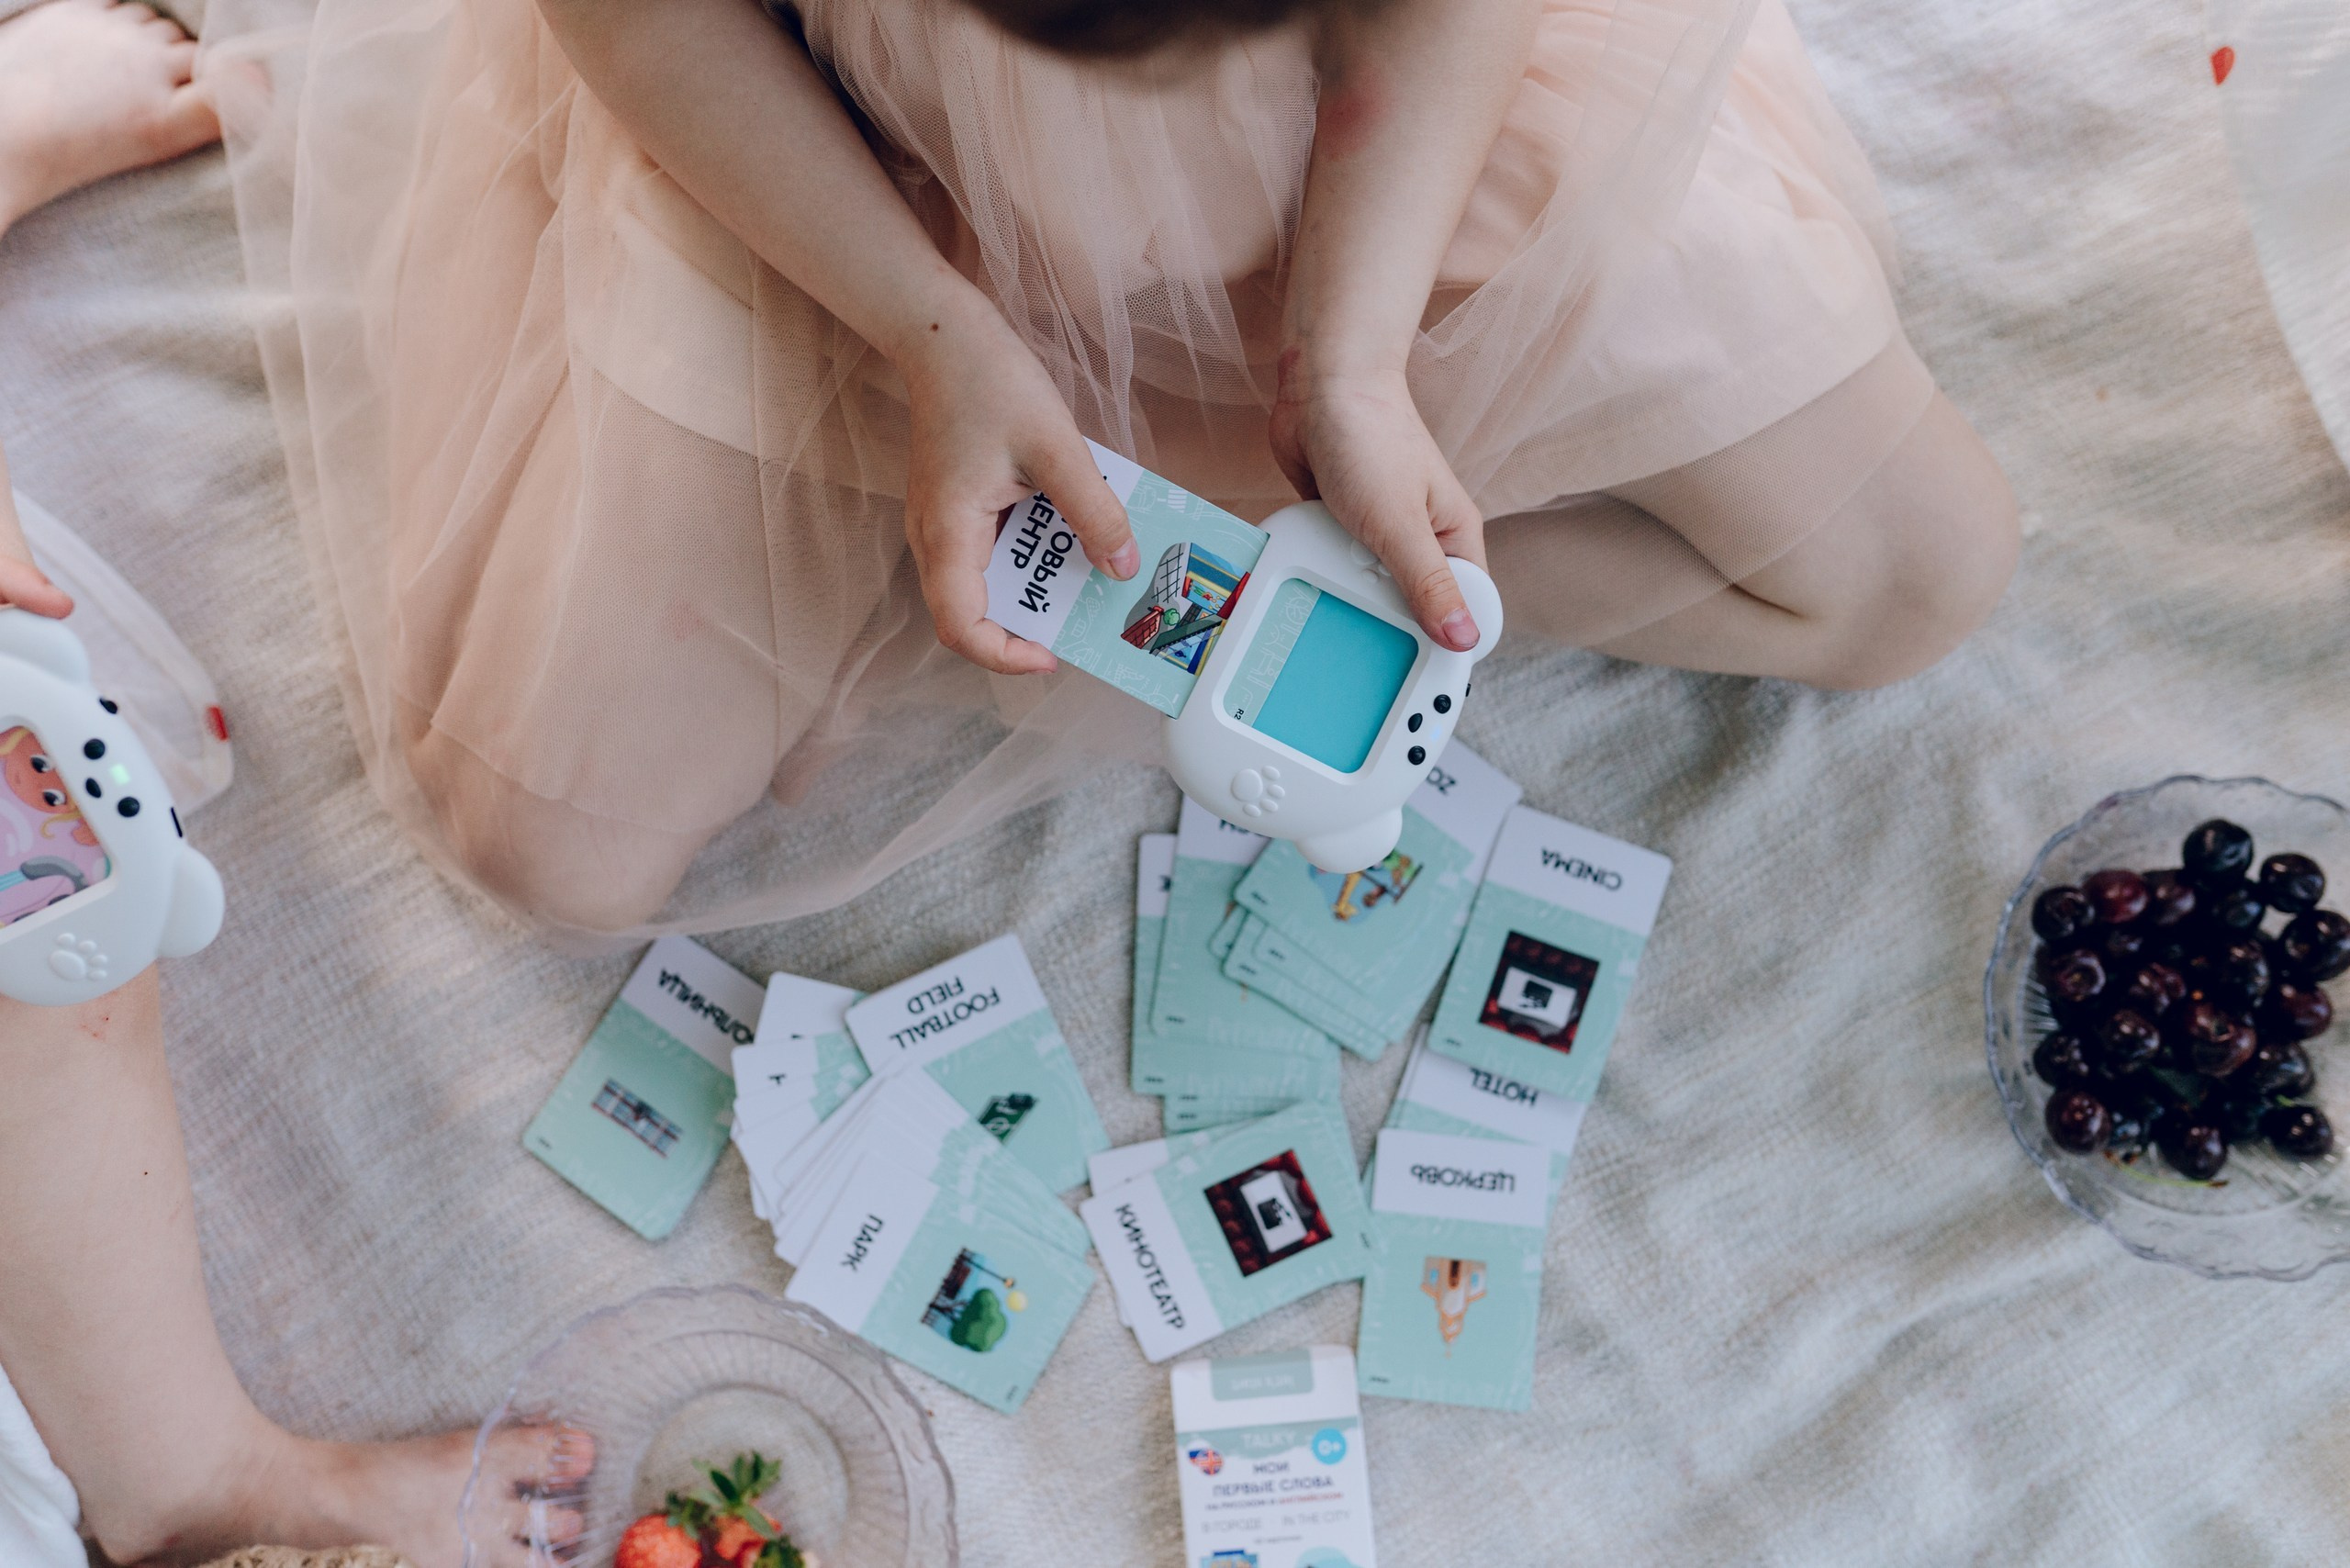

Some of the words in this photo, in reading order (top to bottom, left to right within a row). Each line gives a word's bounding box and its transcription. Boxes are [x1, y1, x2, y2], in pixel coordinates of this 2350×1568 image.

[1426, 766, 1457, 796] ZO
[1540, 846, 1622, 890] CINEMA
[907, 976, 965, 1014] FIELD
[889, 987, 1002, 1049] FOOTBALL
[1470, 1067, 1539, 1107] HOTEL
[1410, 1164, 1515, 1193] ЦЕРКОВЬ
[841, 1214, 885, 1271] ПАРК
[1114, 1203, 1186, 1330] КИНОТЕАТР
[1212, 1479, 1274, 1497] ПЕРВЫЕ
[1279, 1476, 1334, 1492] СЛОВА
